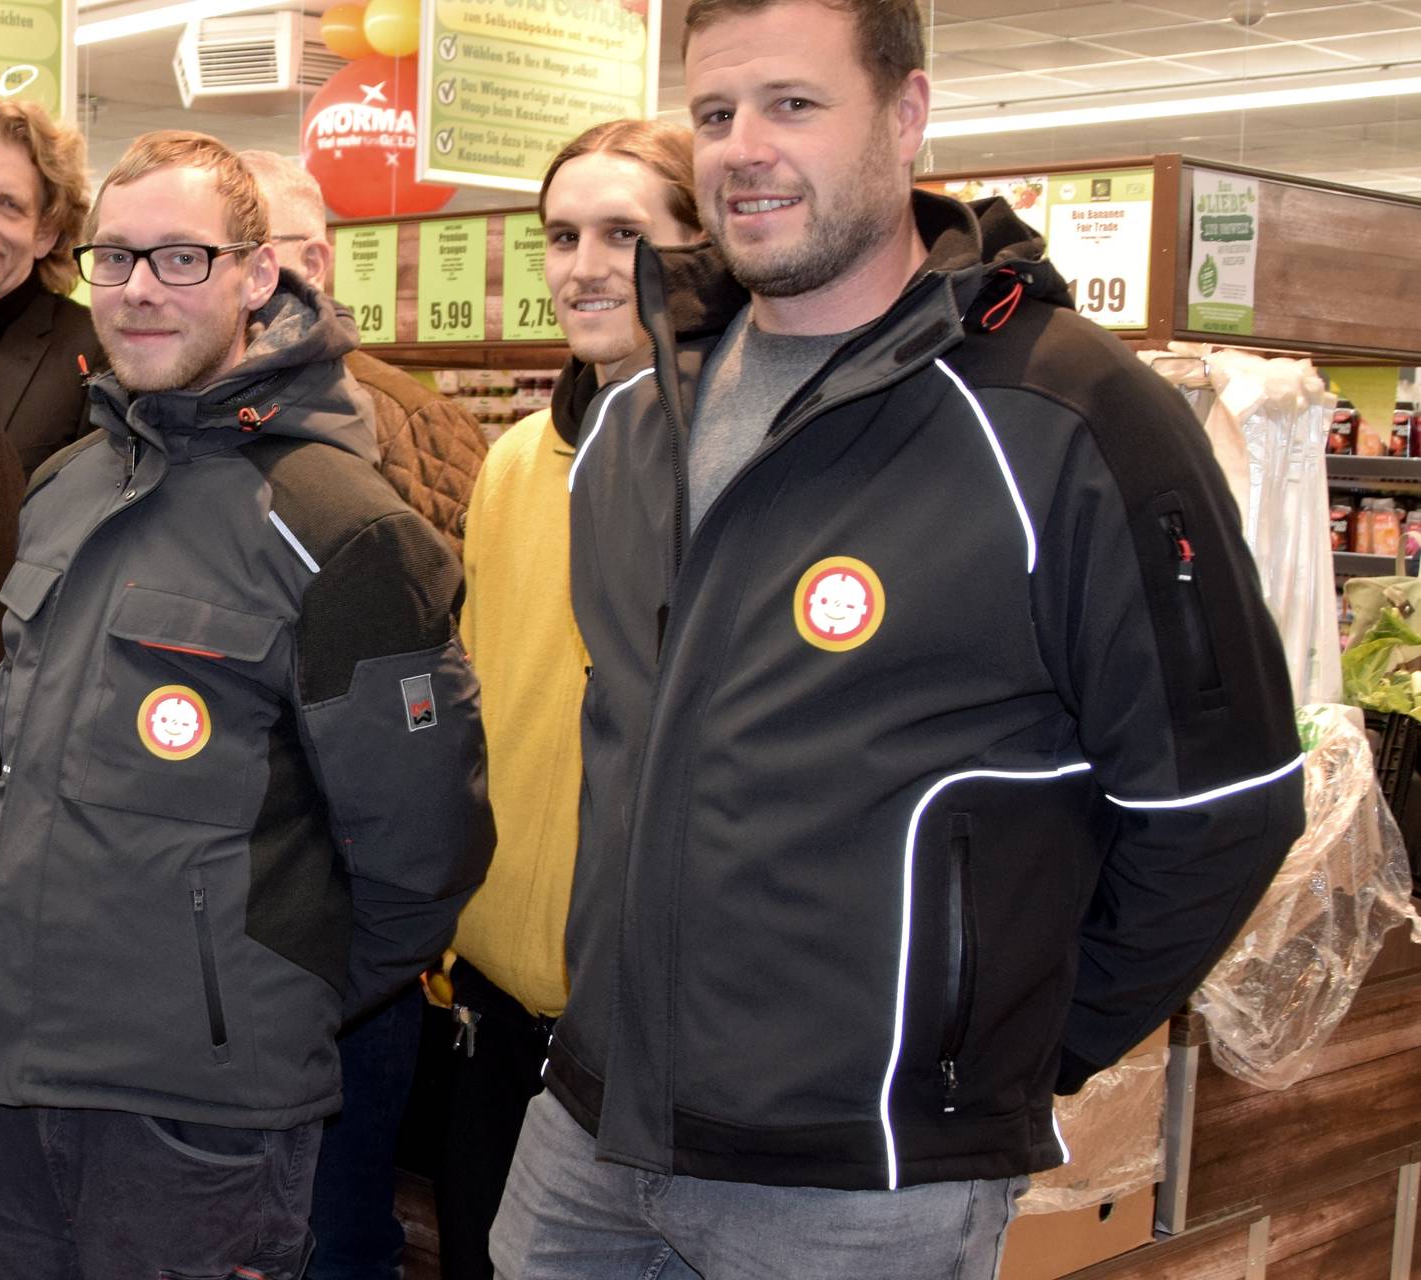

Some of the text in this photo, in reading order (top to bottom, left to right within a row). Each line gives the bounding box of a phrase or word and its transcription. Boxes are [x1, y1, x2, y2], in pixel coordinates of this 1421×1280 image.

[463, 12, 481, 23] zum
[462, 44, 503, 61] Wählen
[506, 51, 520, 65] Sie
[481, 80, 520, 100] Wiegen
[318, 108, 416, 136] NORMA
[516, 107, 569, 126] Kassieren!
[458, 147, 525, 168] Kassenband!
[431, 301, 472, 330] 5,99
